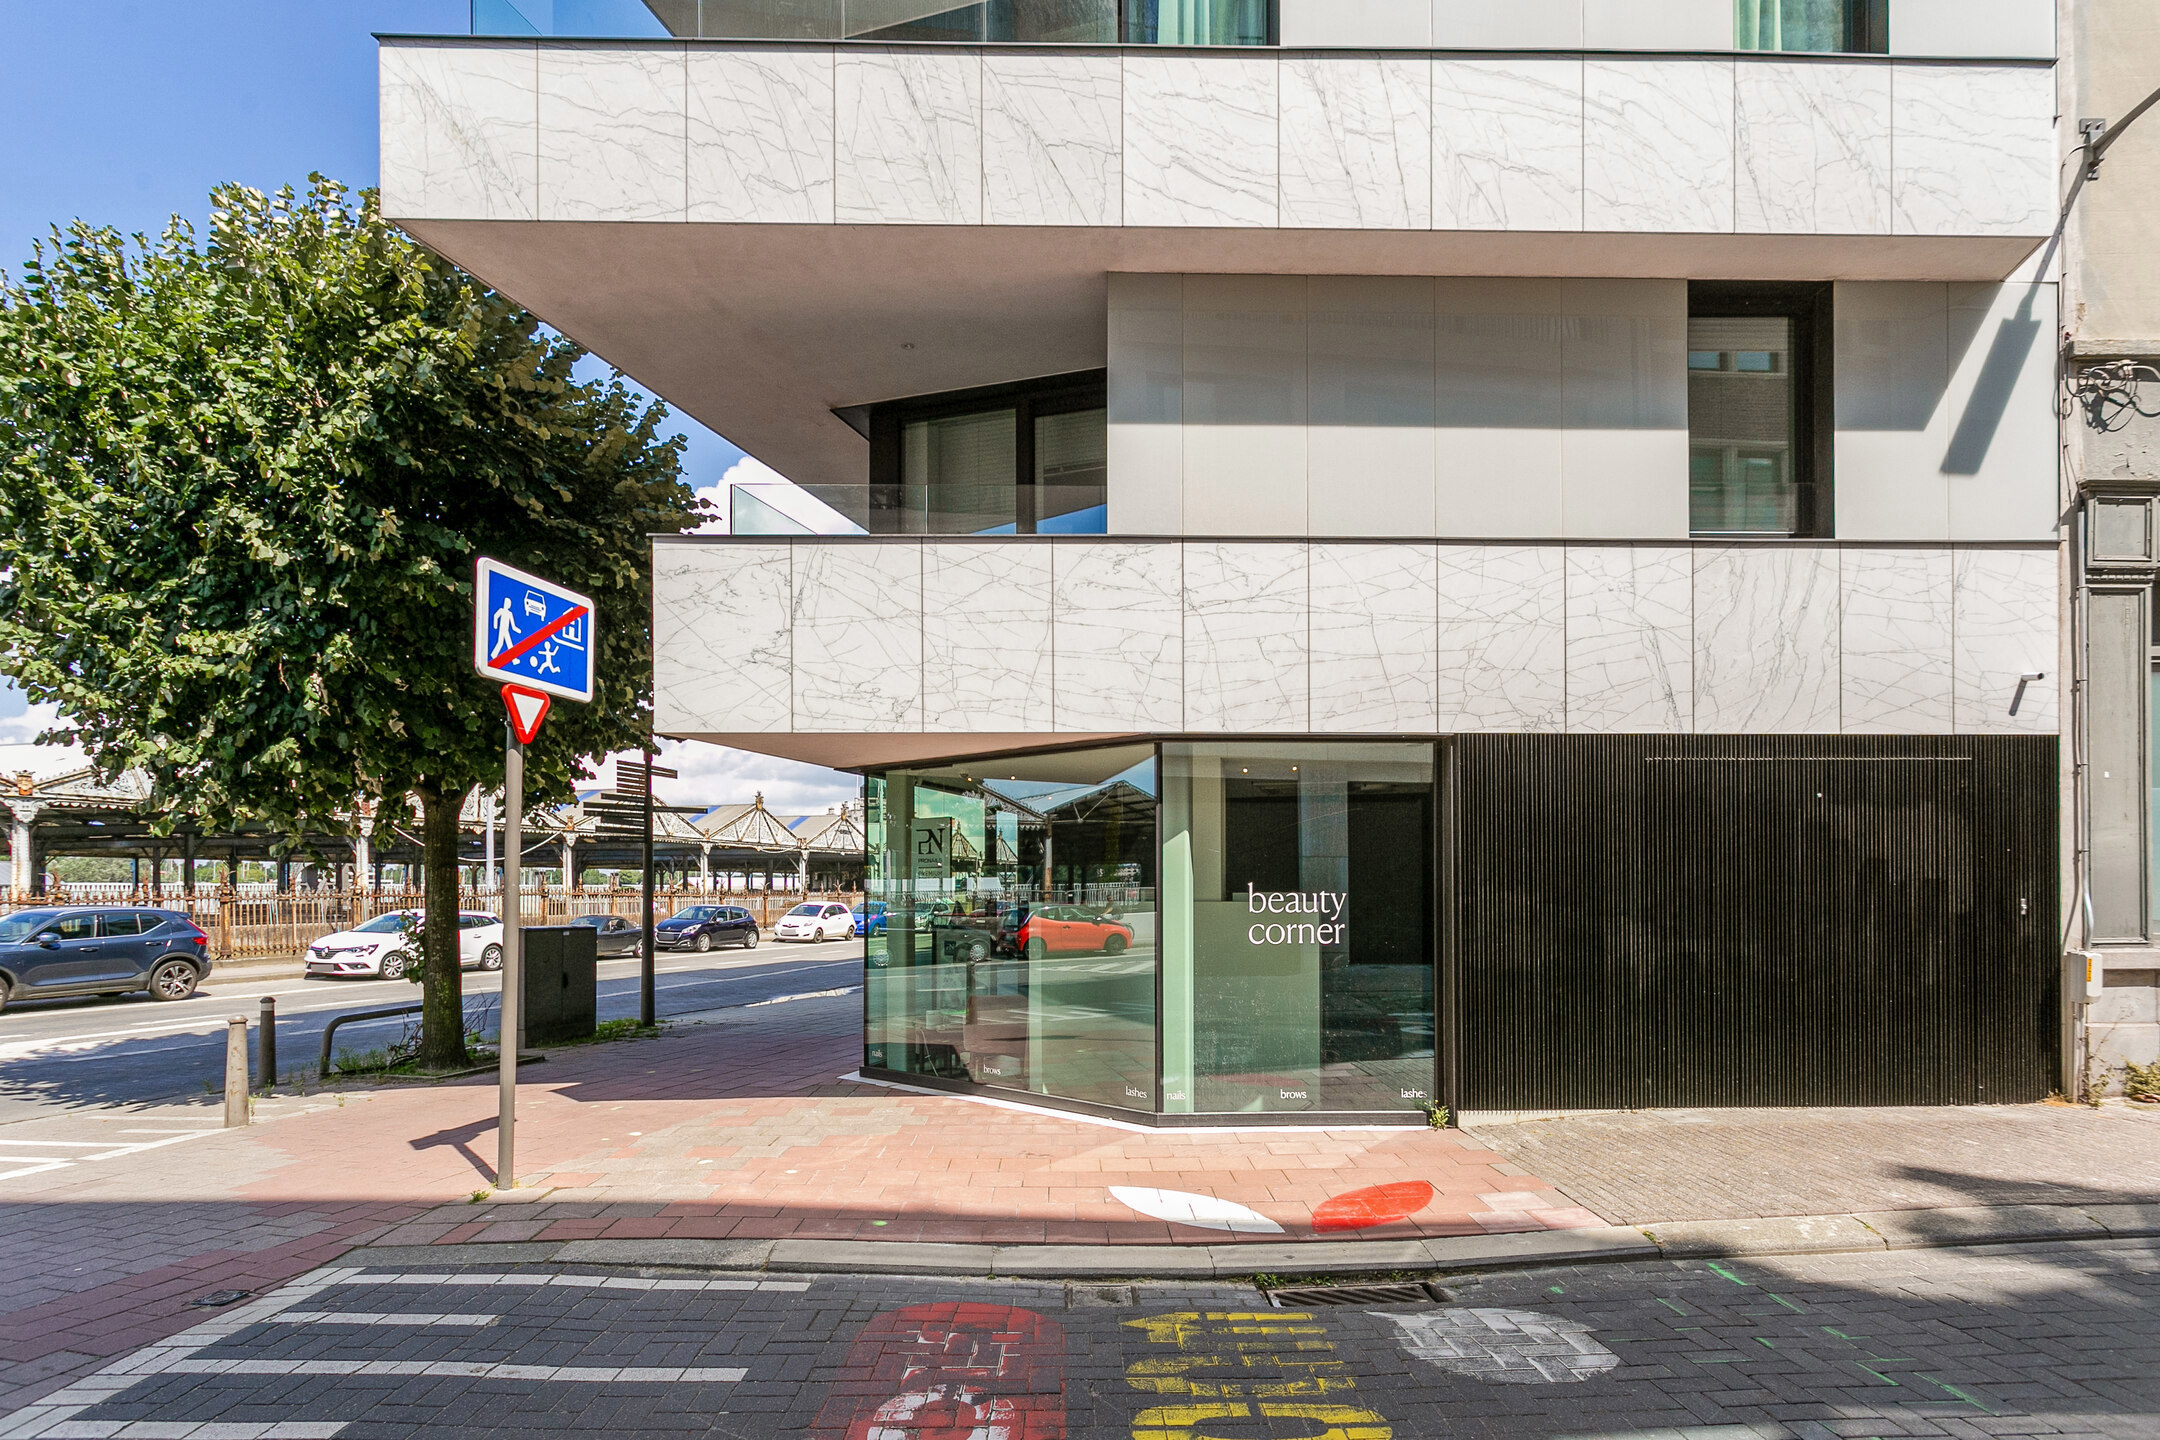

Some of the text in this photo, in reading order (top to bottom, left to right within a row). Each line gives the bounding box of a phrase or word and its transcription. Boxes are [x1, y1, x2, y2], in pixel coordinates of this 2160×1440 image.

[1247, 881, 1347, 921] beauty
[1248, 923, 1346, 945] corner
[871, 1049, 1148, 1099] nails brows lashes
[1166, 1088, 1428, 1100] nails brows lashes
